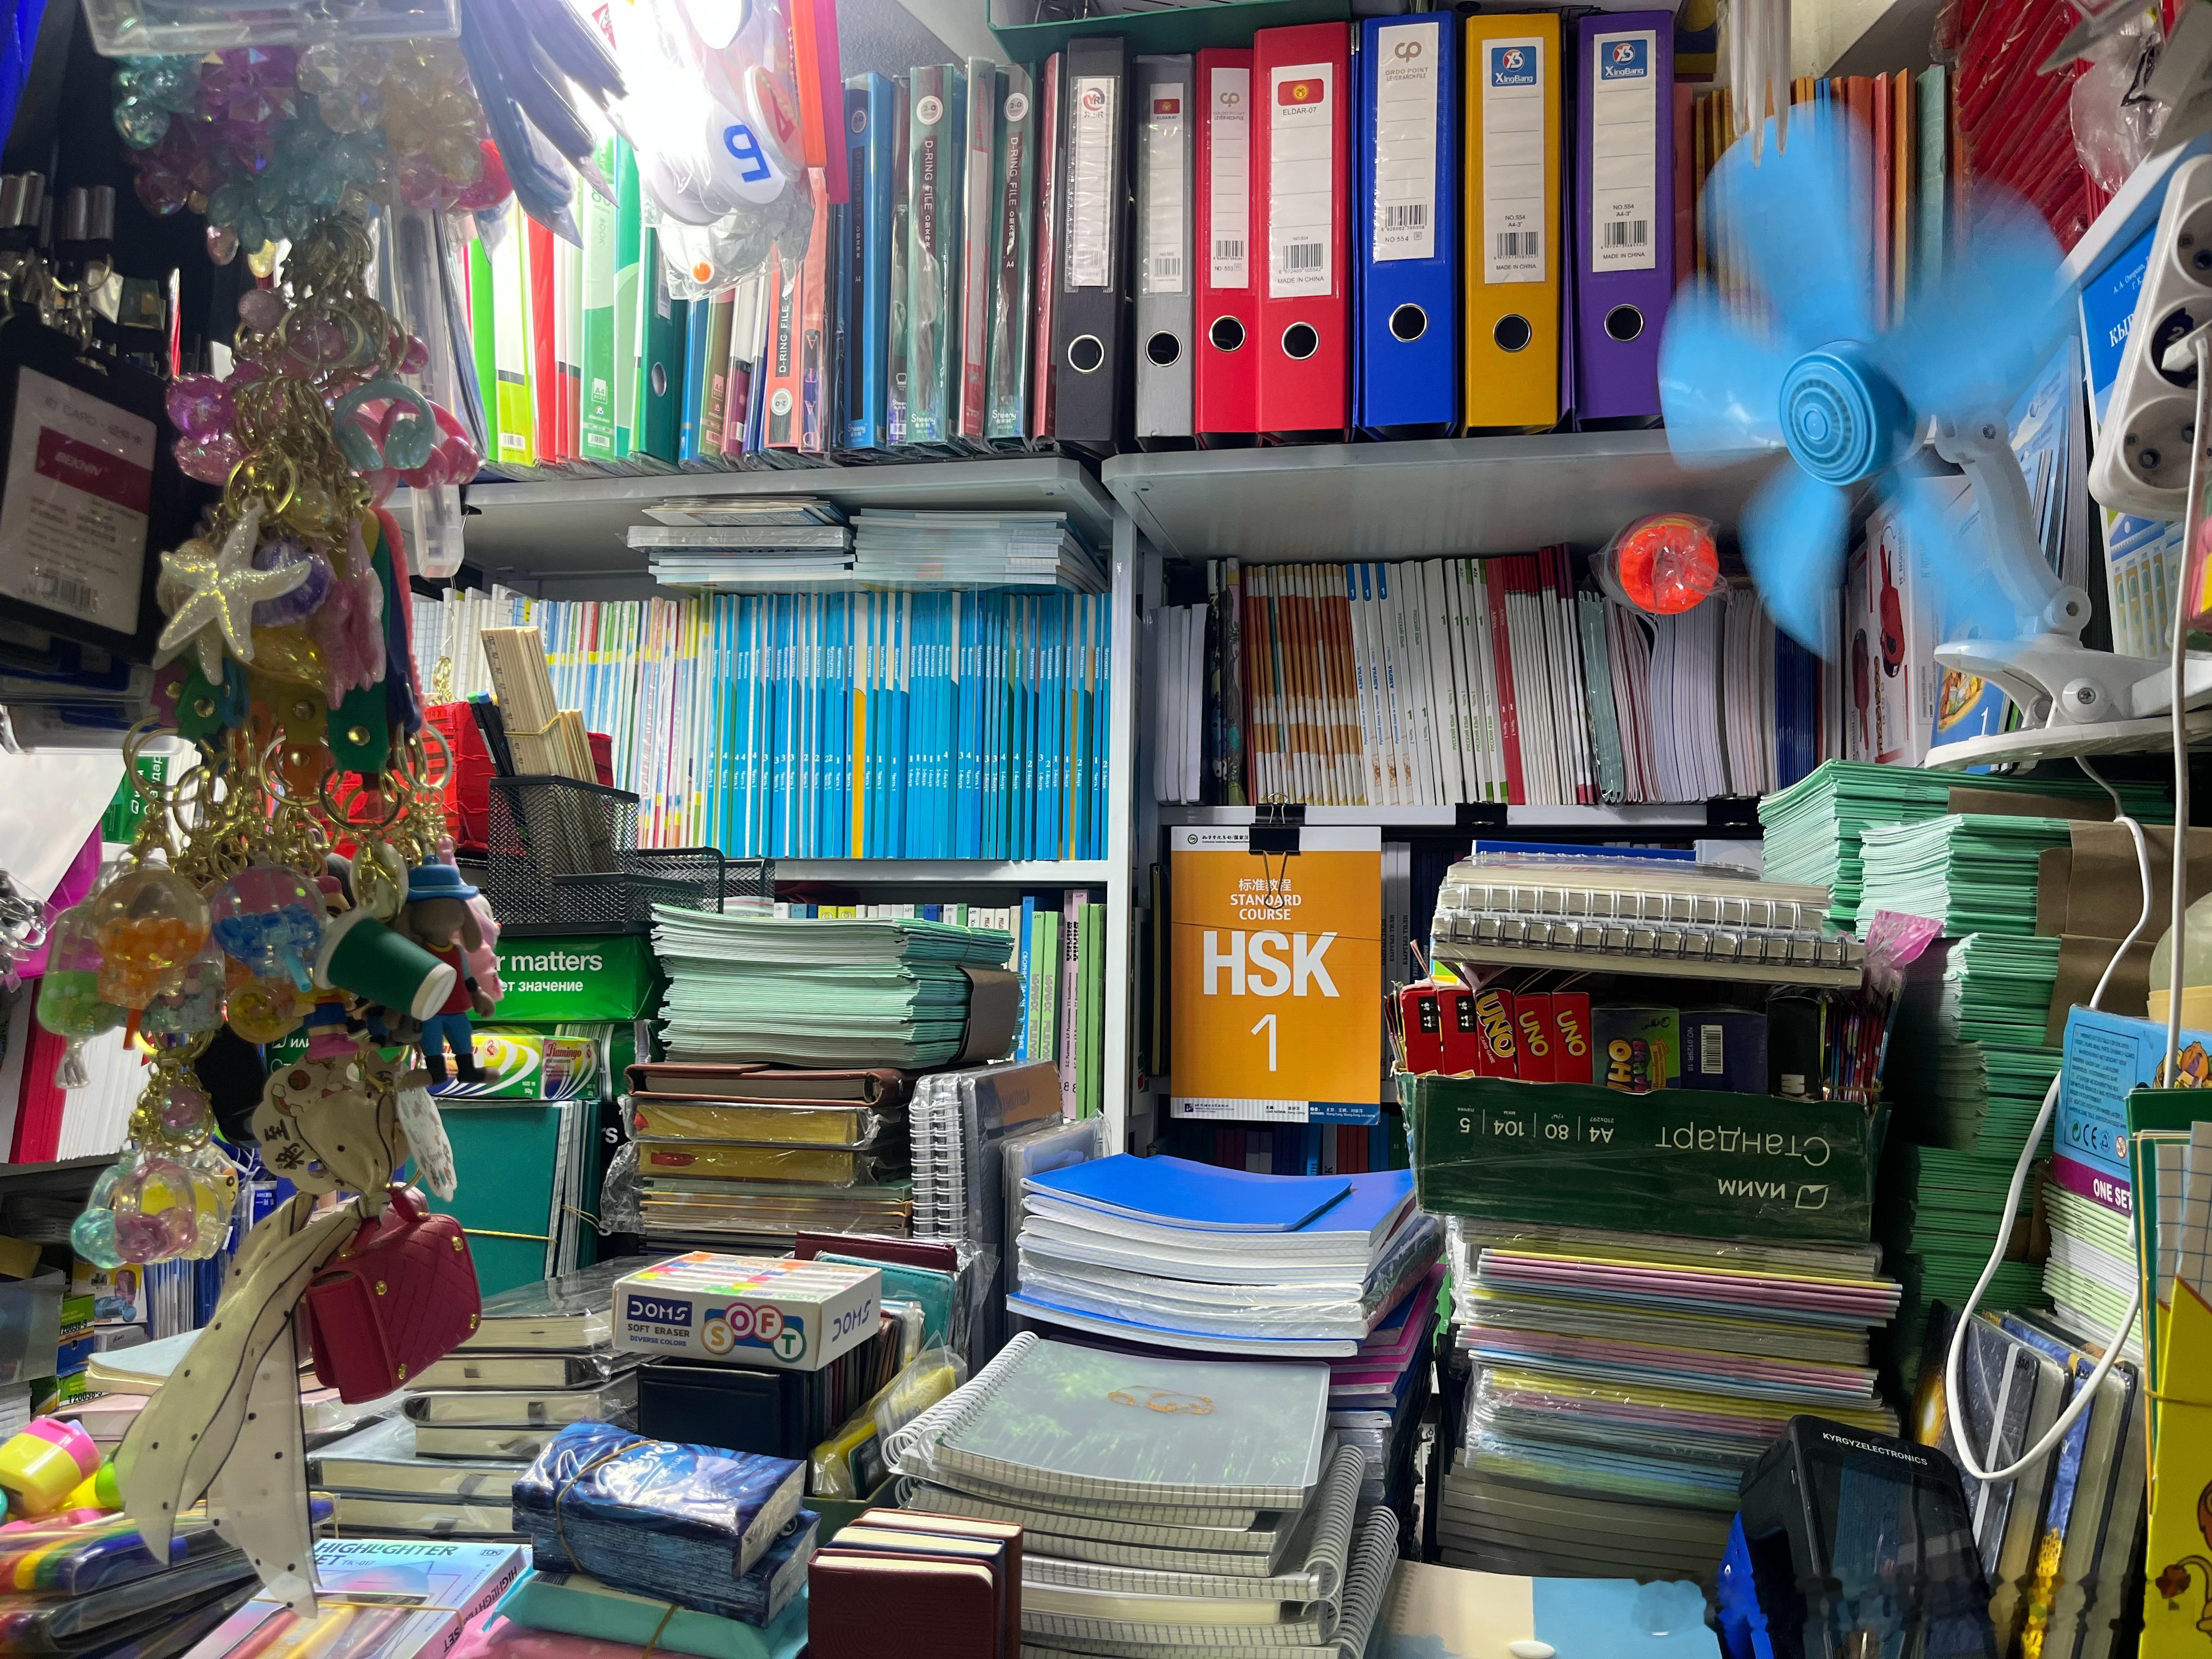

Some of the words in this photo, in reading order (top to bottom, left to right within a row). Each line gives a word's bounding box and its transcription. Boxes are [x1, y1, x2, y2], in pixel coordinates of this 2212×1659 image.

[1496, 72, 1533, 83] XingBang
[1605, 66, 1644, 77] XingBang
[1283, 107, 1316, 115] ELDAR-07
[924, 140, 933, 181] D-RING
[1009, 137, 1018, 177] D-RING
[924, 185, 933, 211] FILE
[1008, 183, 1017, 206] FILE
[779, 334, 788, 373] D-RING
[911, 414, 935, 425] Sheeny
[992, 410, 1016, 420] Sheeny
[848, 424, 866, 434] Sheeny
[1441, 615, 1446, 625] 1
[1455, 616, 1459, 626] 1
[1465, 616, 1469, 626] 1
[1479, 616, 1483, 625] 1
[488, 636, 495, 645] 20
[1408, 710, 1412, 720] 1
[1422, 708, 1426, 717] 1
[1239, 878, 1291, 891] 标准教程
[1230, 894, 1302, 906] STANDARD
[1239, 909, 1291, 921] COURSE
[511, 951, 603, 971] matters
[1204, 930, 1340, 997] HSK
[518, 981, 583, 992] значение
[1031, 974, 1040, 1013] ХИМИЯ
[1045, 974, 1053, 1013] ХИМИЯ
[1477, 991, 1515, 1057] UNO
[1519, 1011, 1548, 1057] UNO
[1557, 1010, 1586, 1056] UNO
[1251, 1014, 1277, 1071] 1
[546, 1043, 582, 1060] Flamingo
[1486, 1050, 1496, 1064] GAME
[1064, 1081, 1069, 1091] 8
[1460, 1118, 1470, 1133] 5
[1494, 1119, 1524, 1136] 104
[1545, 1124, 1569, 1140] 80
[1589, 1127, 1613, 1143] A4
[1656, 1122, 1830, 1166] Стандарт
[1718, 1179, 1785, 1200] ИЛИМ
[2094, 1178, 2113, 1203] ONE
[631, 1301, 689, 1320] DOMS
[832, 1299, 872, 1342] DOMS
[628, 1323, 650, 1334] SOFT
[655, 1326, 690, 1338] ERASER
[707, 1306, 800, 1358] SOFT
[630, 1335, 658, 1345] DIVERSE
[661, 1338, 687, 1346] COLORE
[1822, 1432, 1928, 1465] KYRGYZELECTRONICS
[315, 1543, 459, 1556] HIGHLIGHTER
[444, 1626, 460, 1652] SET
